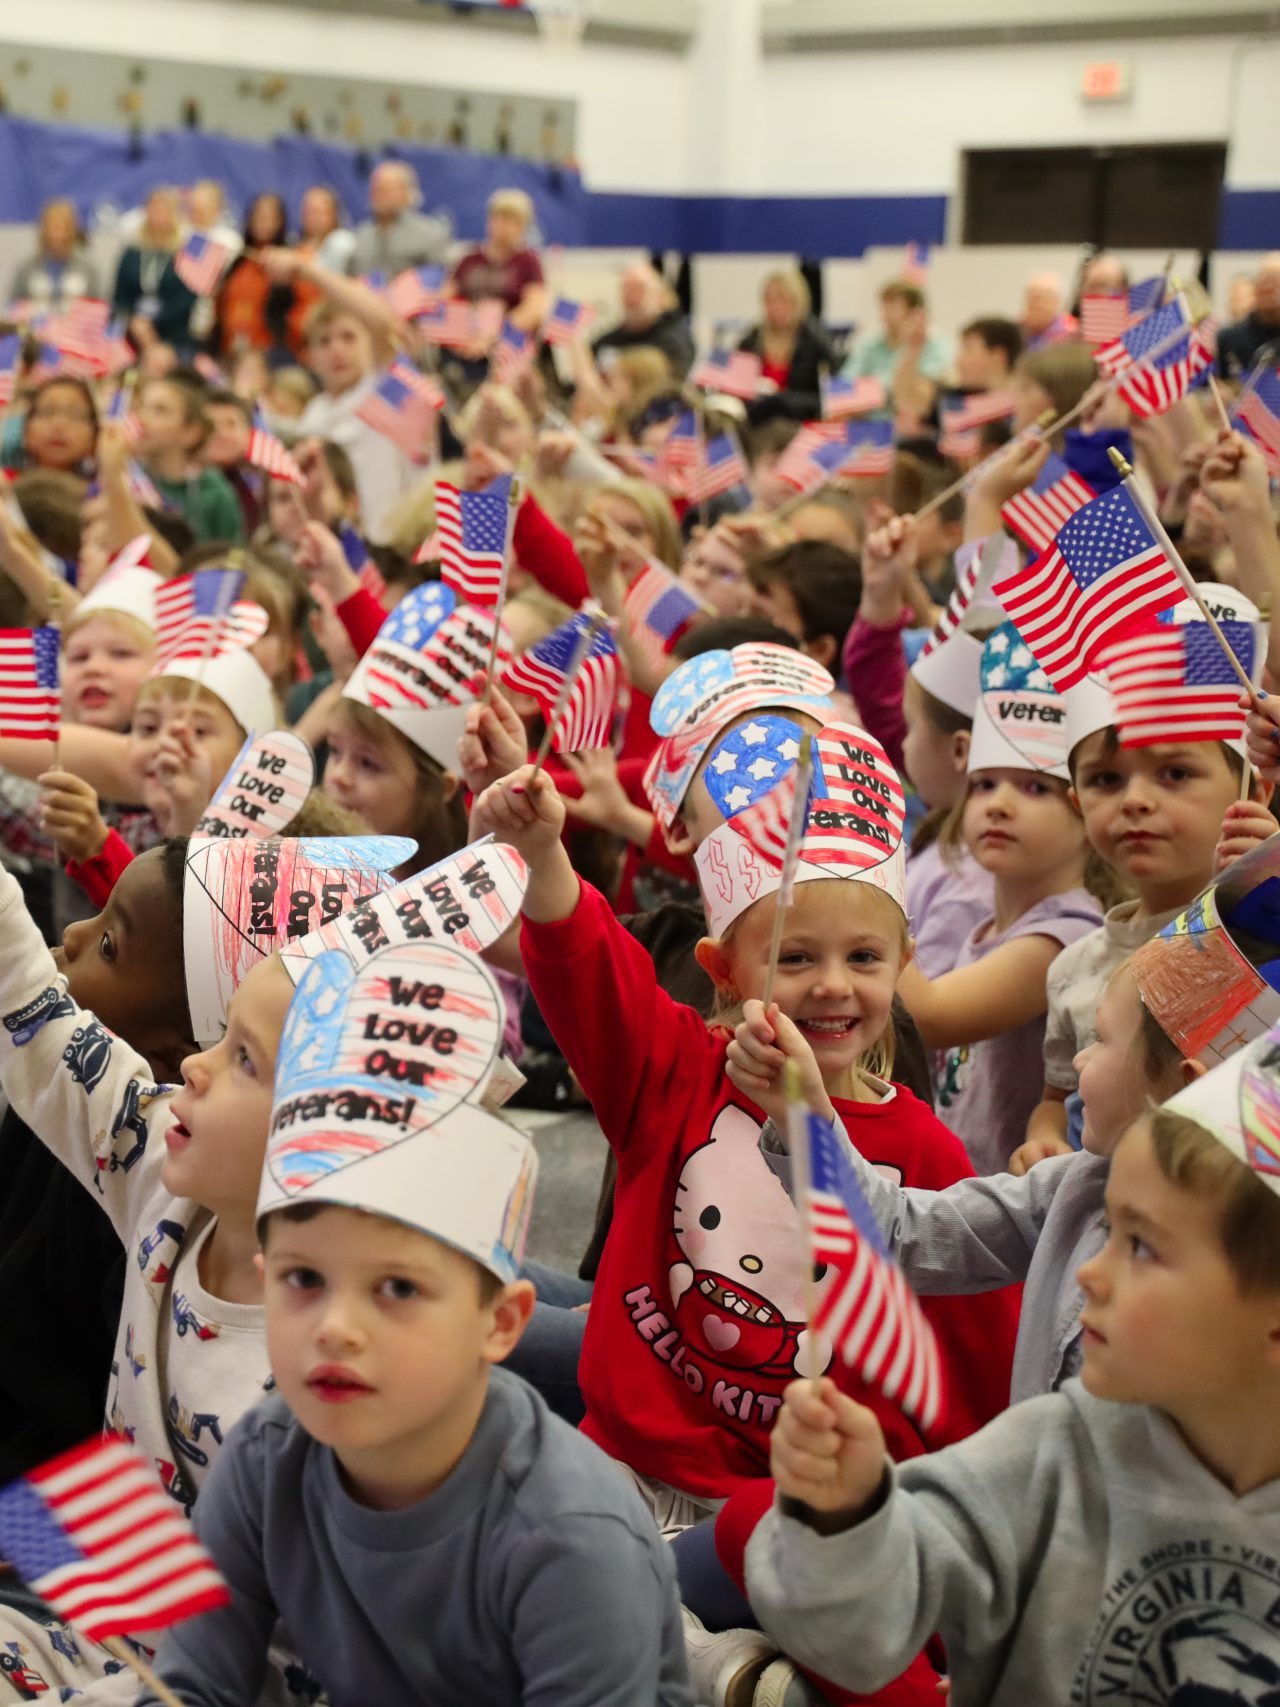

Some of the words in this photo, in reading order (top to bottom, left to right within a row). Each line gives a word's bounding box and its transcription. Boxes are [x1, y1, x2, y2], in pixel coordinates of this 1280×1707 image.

[999, 701, 1067, 723] Veter
[258, 750, 287, 775] We
[840, 740, 876, 770] We
[237, 771, 285, 804] Love
[838, 763, 892, 803] Love
[230, 795, 265, 821] Our
[852, 788, 890, 820] Our
[810, 810, 892, 850] erans!
[459, 858, 496, 899] We
[396, 899, 433, 939] Our
[423, 874, 470, 935] Love
[389, 976, 445, 1010] We
[363, 1013, 458, 1055] Love
[365, 1049, 435, 1086] Our
[624, 1285, 704, 1394] HELLO
[712, 1380, 783, 1423] KIT
[1140, 1539, 1212, 1570] SHORE
[1240, 1545, 1280, 1579] VIR
[1097, 1566, 1245, 1698] VIRGINIA
